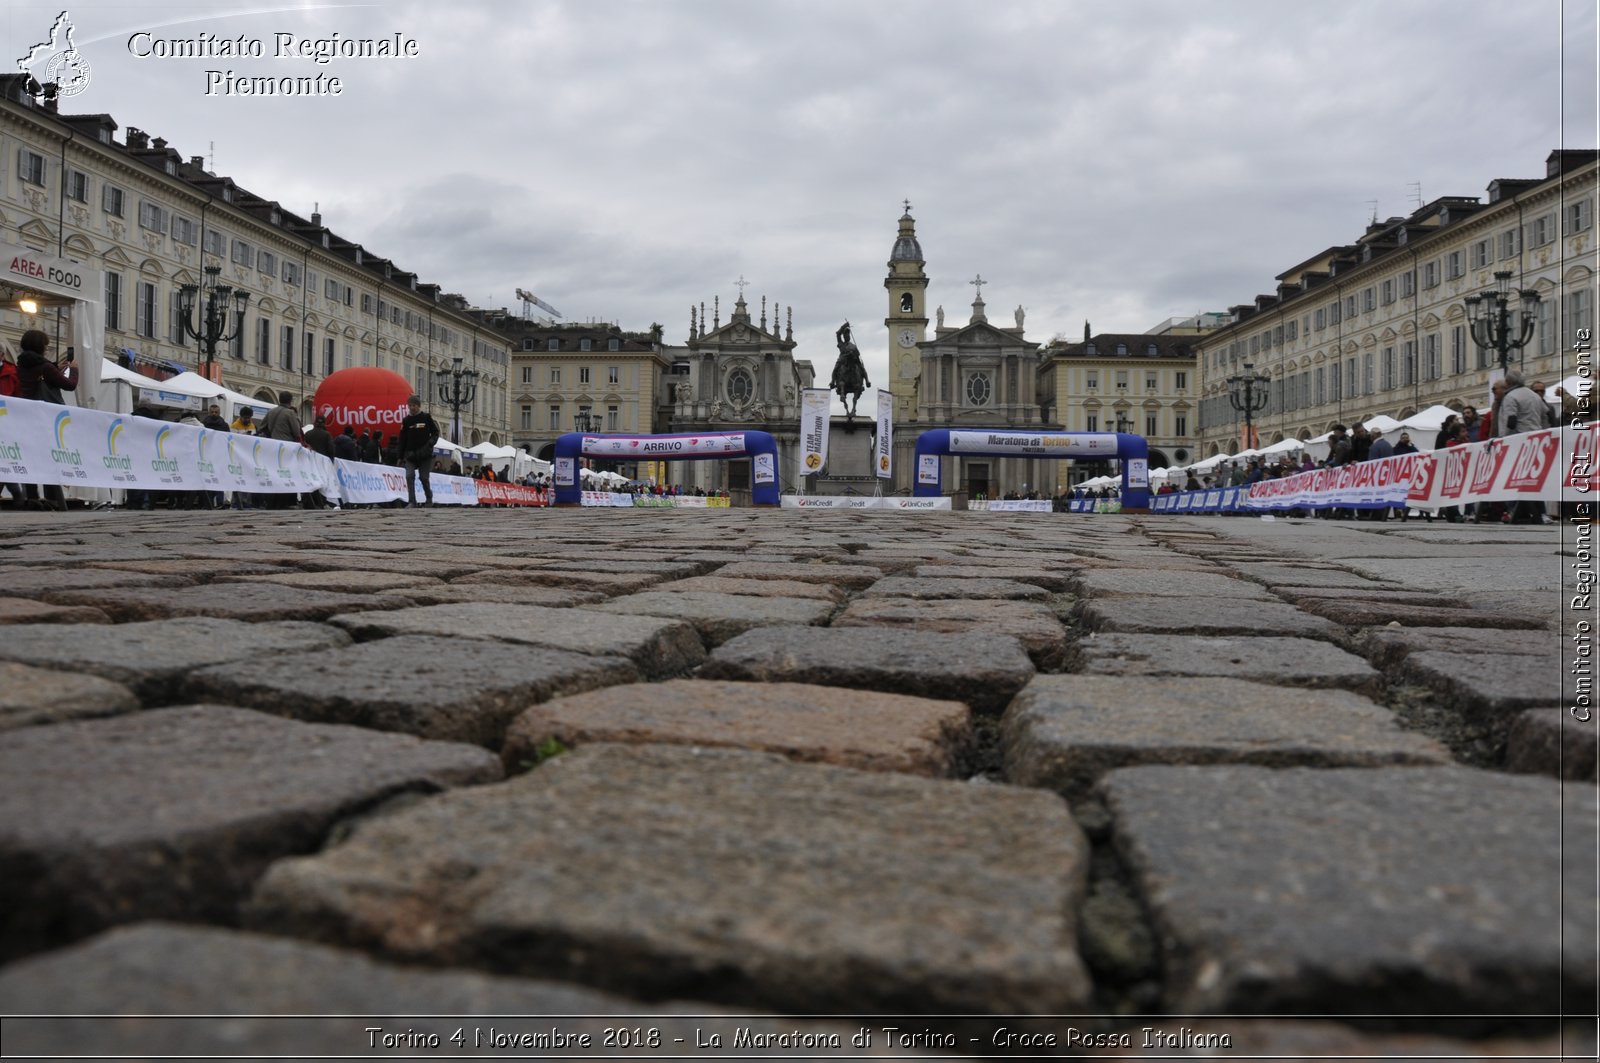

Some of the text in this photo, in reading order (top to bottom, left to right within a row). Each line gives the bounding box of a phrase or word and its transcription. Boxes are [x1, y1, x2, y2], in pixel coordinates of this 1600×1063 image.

[10, 256, 82, 288] AREA FOOD
[335, 404, 409, 425] UniCredit
[806, 433, 815, 452] TEAM
[814, 415, 823, 453] MARATHON
[988, 435, 1029, 446] Maratona
[1031, 438, 1040, 447] di
[1042, 436, 1071, 447] Torino
[643, 441, 682, 451] ARRIVO
[51, 448, 83, 466] amiat
[103, 454, 132, 470] amiat
[151, 457, 179, 473] amiat
[1511, 435, 1551, 480] RDS
[1445, 450, 1466, 489] RDS
[907, 500, 934, 508] UniCredit
